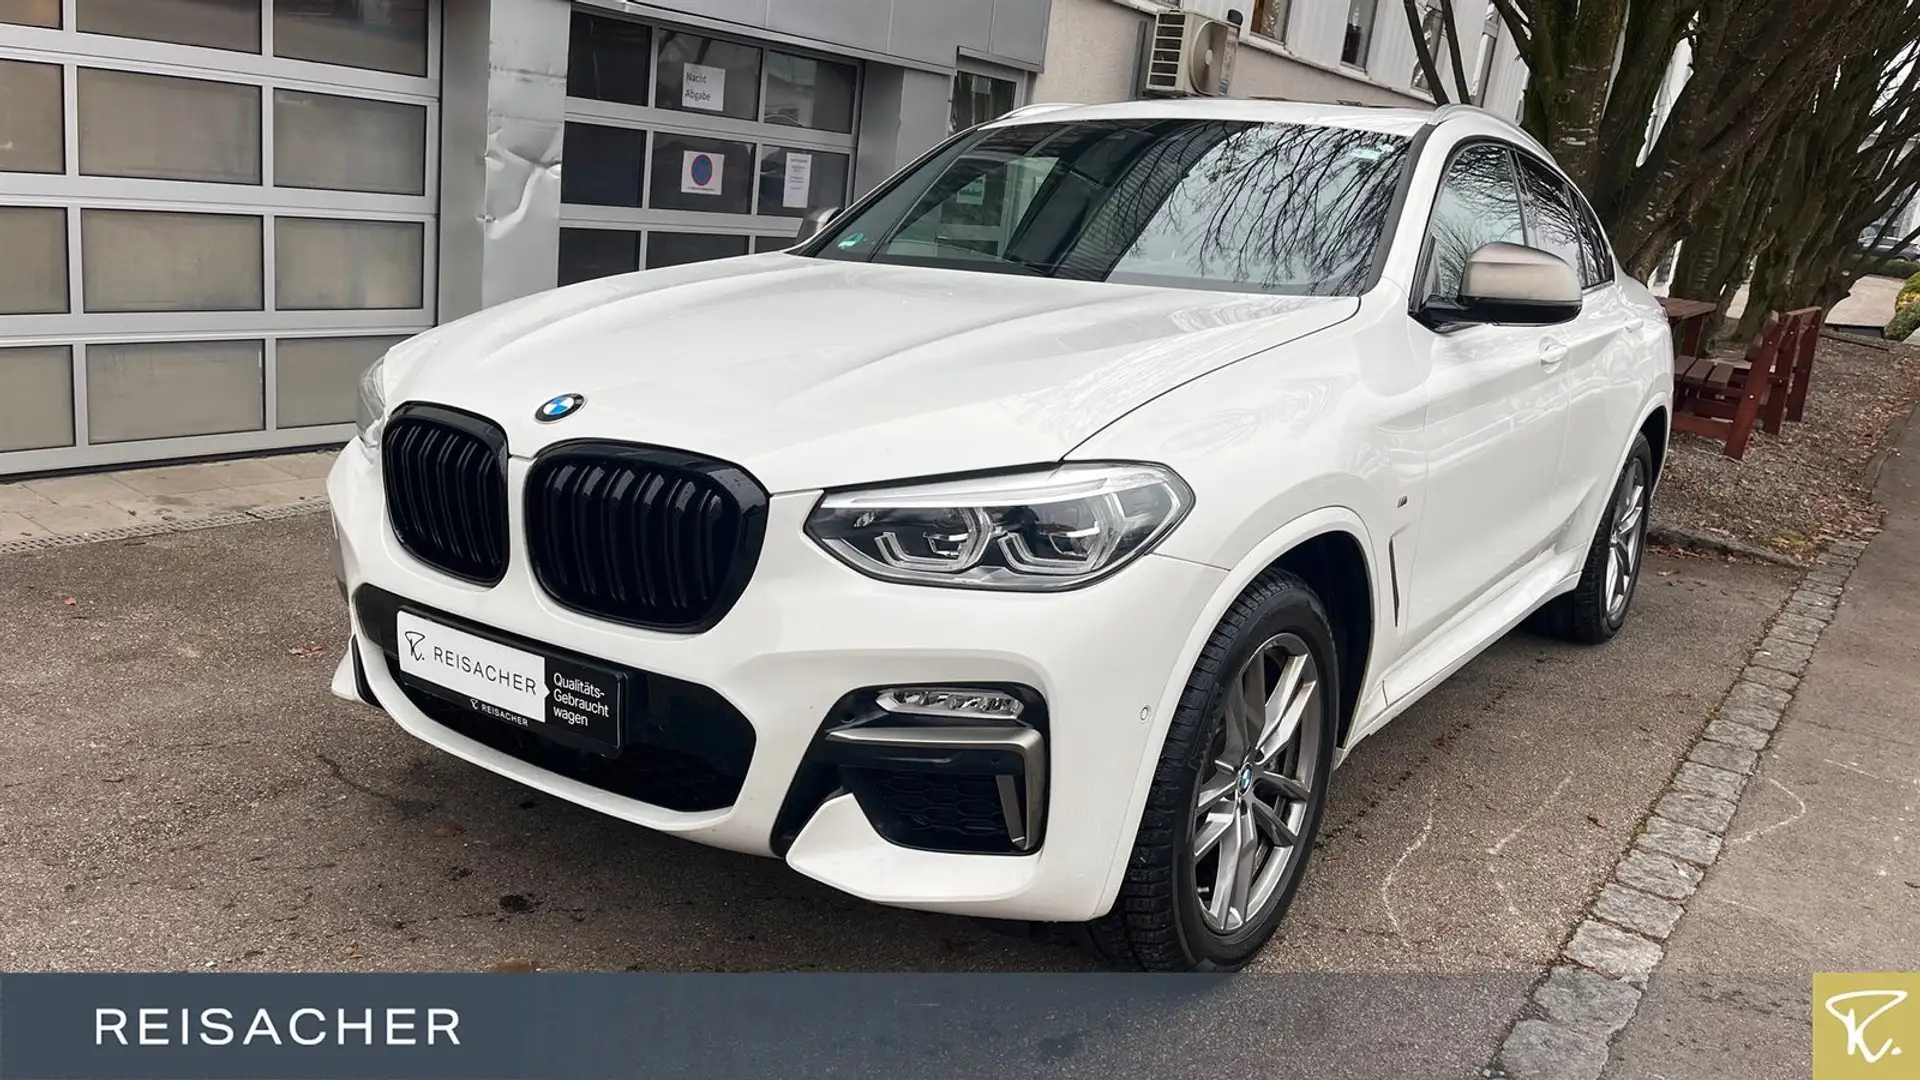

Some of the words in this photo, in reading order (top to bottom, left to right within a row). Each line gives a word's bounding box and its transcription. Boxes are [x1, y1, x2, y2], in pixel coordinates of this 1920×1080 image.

[433, 646, 537, 696] REISACHER
[553, 672, 605, 698] Qualitäts-
[481, 703, 529, 727] REISACHER
[553, 691, 610, 718] Gebraucht
[553, 707, 589, 727] wagen
